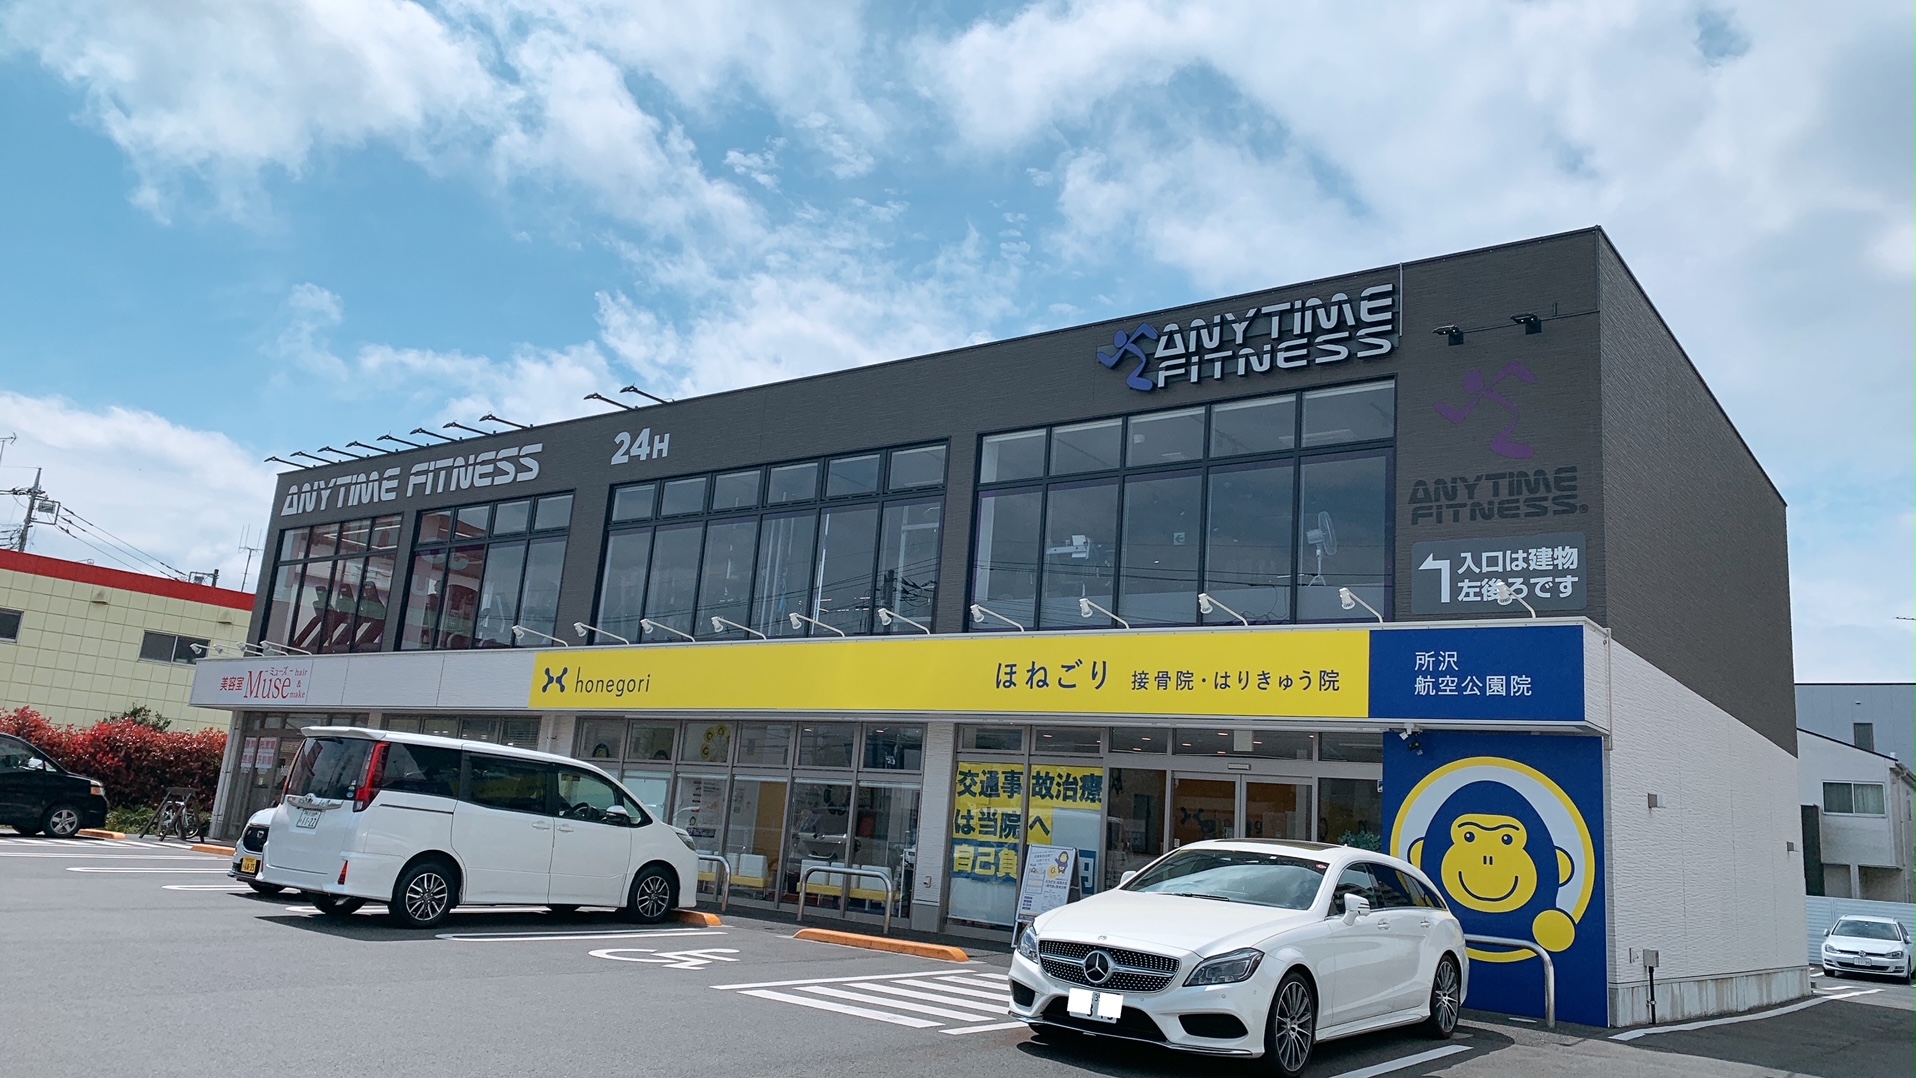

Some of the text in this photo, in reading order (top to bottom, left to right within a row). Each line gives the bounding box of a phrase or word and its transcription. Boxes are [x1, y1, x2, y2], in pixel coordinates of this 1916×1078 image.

[1154, 283, 1394, 359] ANYTIME
[1157, 325, 1393, 388] FITNESS
[611, 428, 670, 465] 24H
[281, 443, 543, 516] ANYTIME FITNESS
[1408, 466, 1578, 505] ANYTIME
[1457, 546, 1578, 574] 入口は建物
[995, 658, 1340, 692] ほねごり 接骨院・はりきゅう院
[1414, 651, 1459, 671] 所沢
[219, 670, 291, 699] 美容室 Muse
[575, 666, 651, 697] honegori
[1414, 675, 1532, 697] 航空公園院
